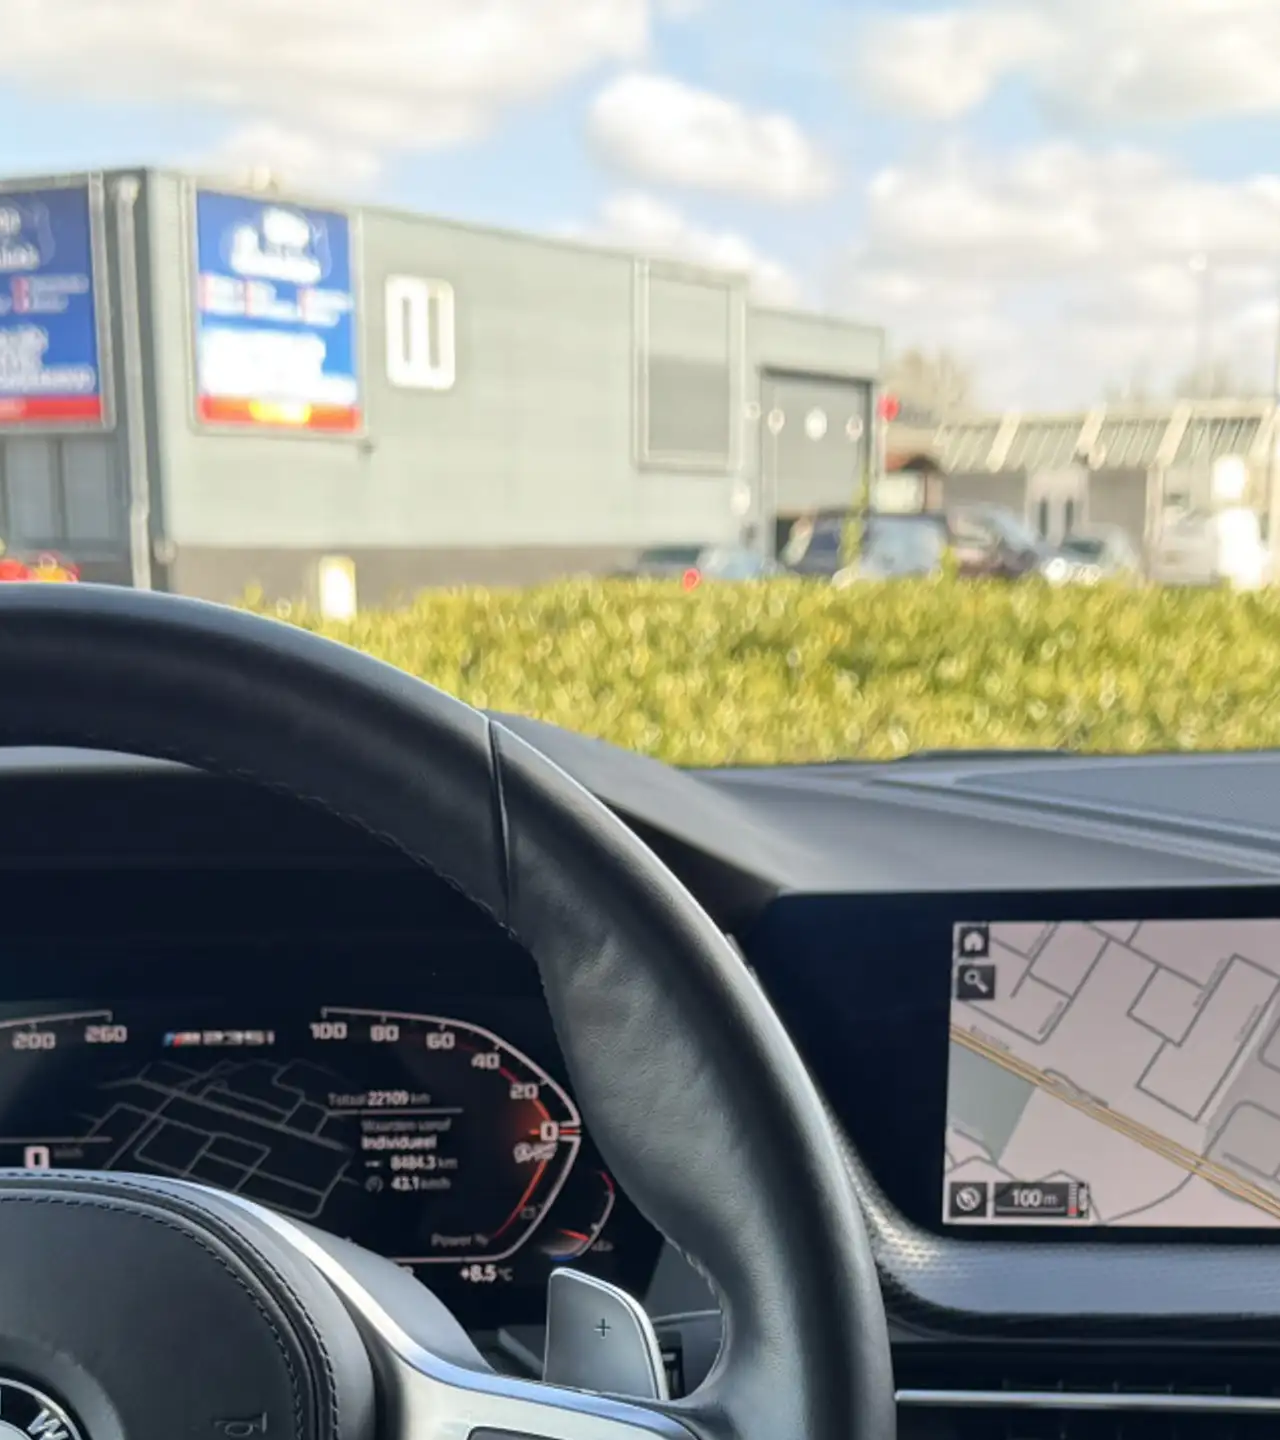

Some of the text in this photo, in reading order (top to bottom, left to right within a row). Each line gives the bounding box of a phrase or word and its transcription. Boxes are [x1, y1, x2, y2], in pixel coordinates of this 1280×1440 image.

[84, 1024, 128, 1043] 260
[310, 1022, 348, 1040] 100
[370, 1024, 400, 1042] 80
[12, 1031, 56, 1050] 200
[425, 1032, 456, 1050] 60
[471, 1052, 500, 1070] 40
[509, 1082, 539, 1100] 20
[539, 1120, 559, 1142] 0
[24, 1145, 50, 1169] 0
[1011, 1188, 1044, 1207] 100
